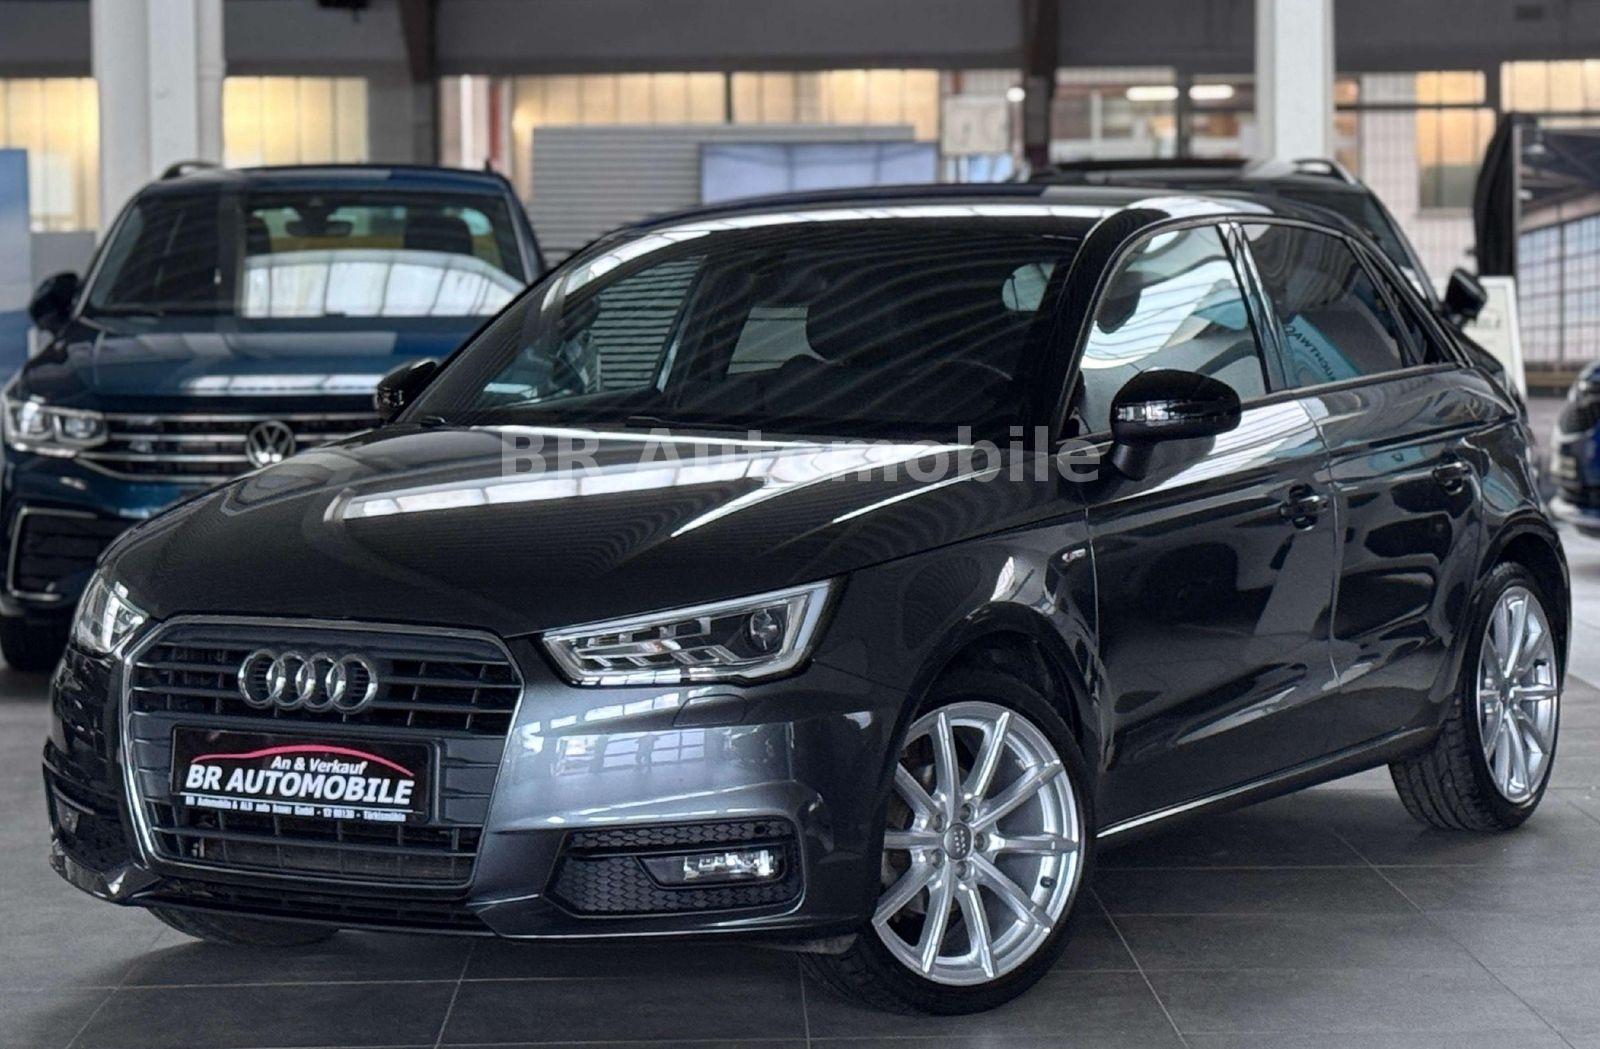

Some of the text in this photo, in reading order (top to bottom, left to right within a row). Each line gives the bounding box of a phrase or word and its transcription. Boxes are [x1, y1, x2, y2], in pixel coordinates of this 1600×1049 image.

[270, 756, 368, 775] An & Verkauf
[185, 764, 415, 805] BR AUTOMOBILE
